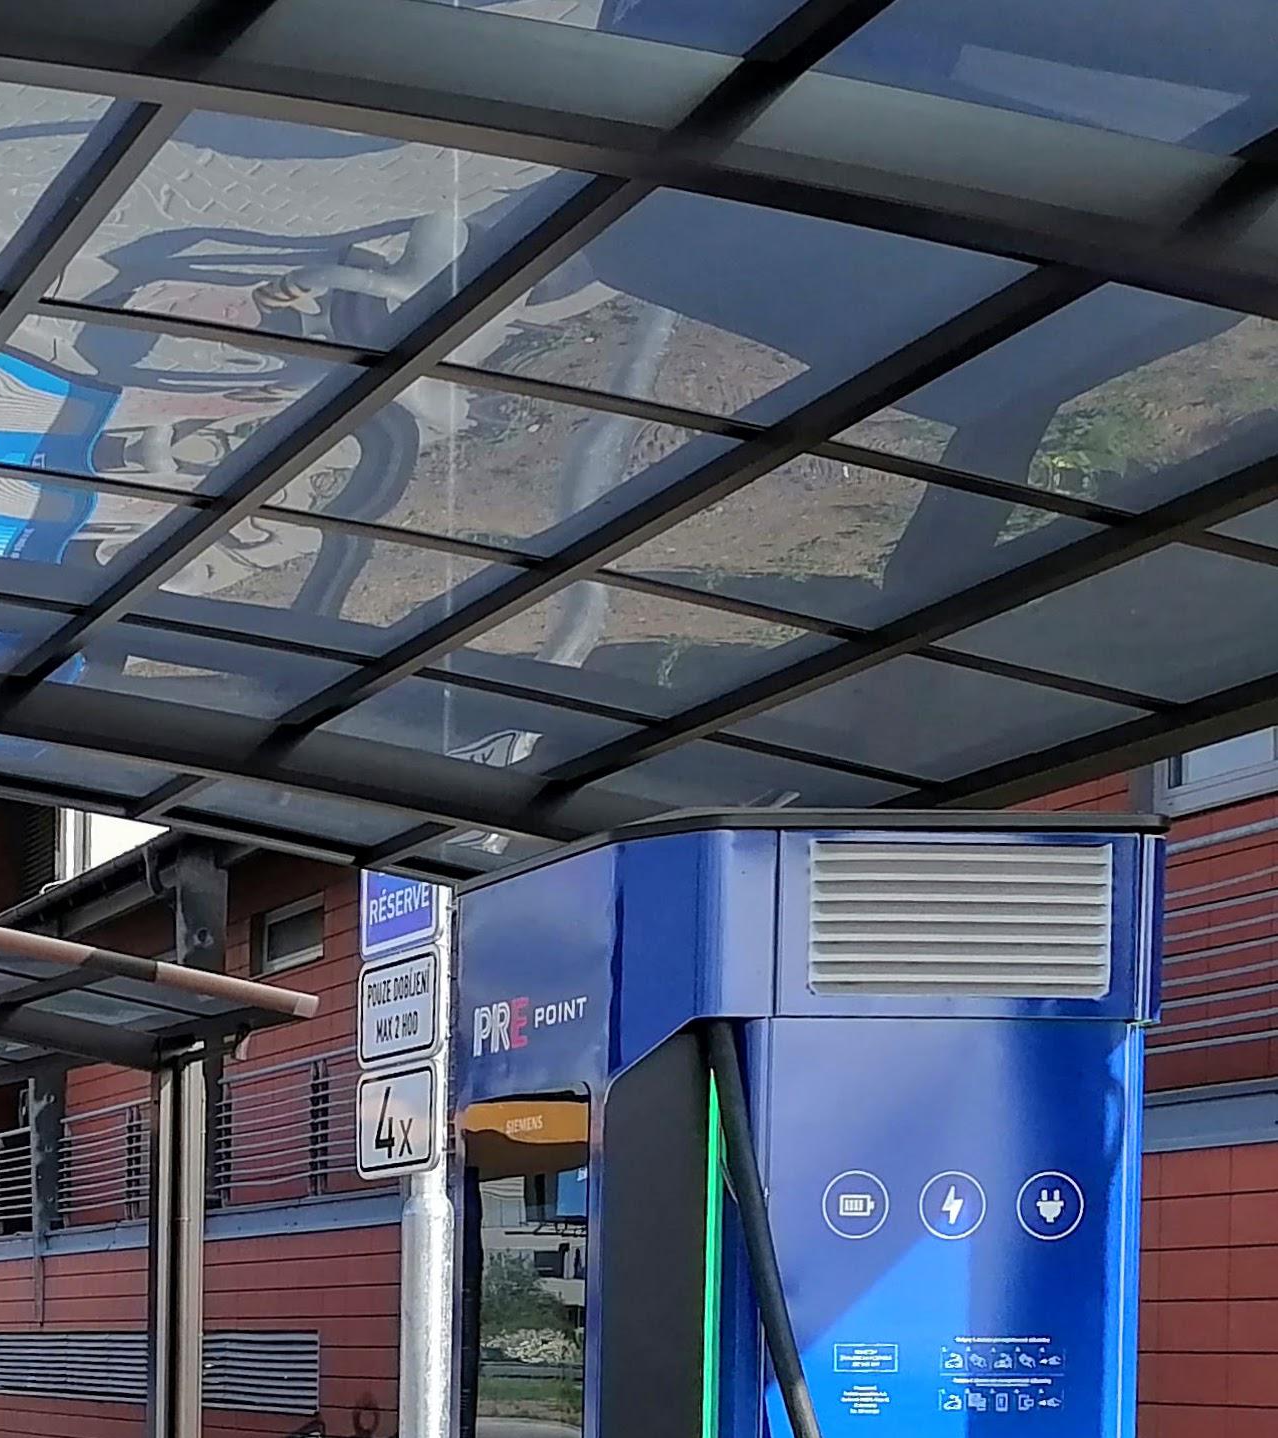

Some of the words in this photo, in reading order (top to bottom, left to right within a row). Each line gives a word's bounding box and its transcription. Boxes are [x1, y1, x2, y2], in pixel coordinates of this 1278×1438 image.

[367, 979, 392, 1008] POUZE
[393, 964, 430, 1001] DOBÍJENÍ
[376, 1017, 393, 1043] MAX
[394, 1015, 400, 1039] 2
[401, 1011, 418, 1037] HOD
[473, 996, 530, 1057] PRE
[535, 996, 588, 1028] POINT
[506, 1115, 543, 1134] SIEMENS
